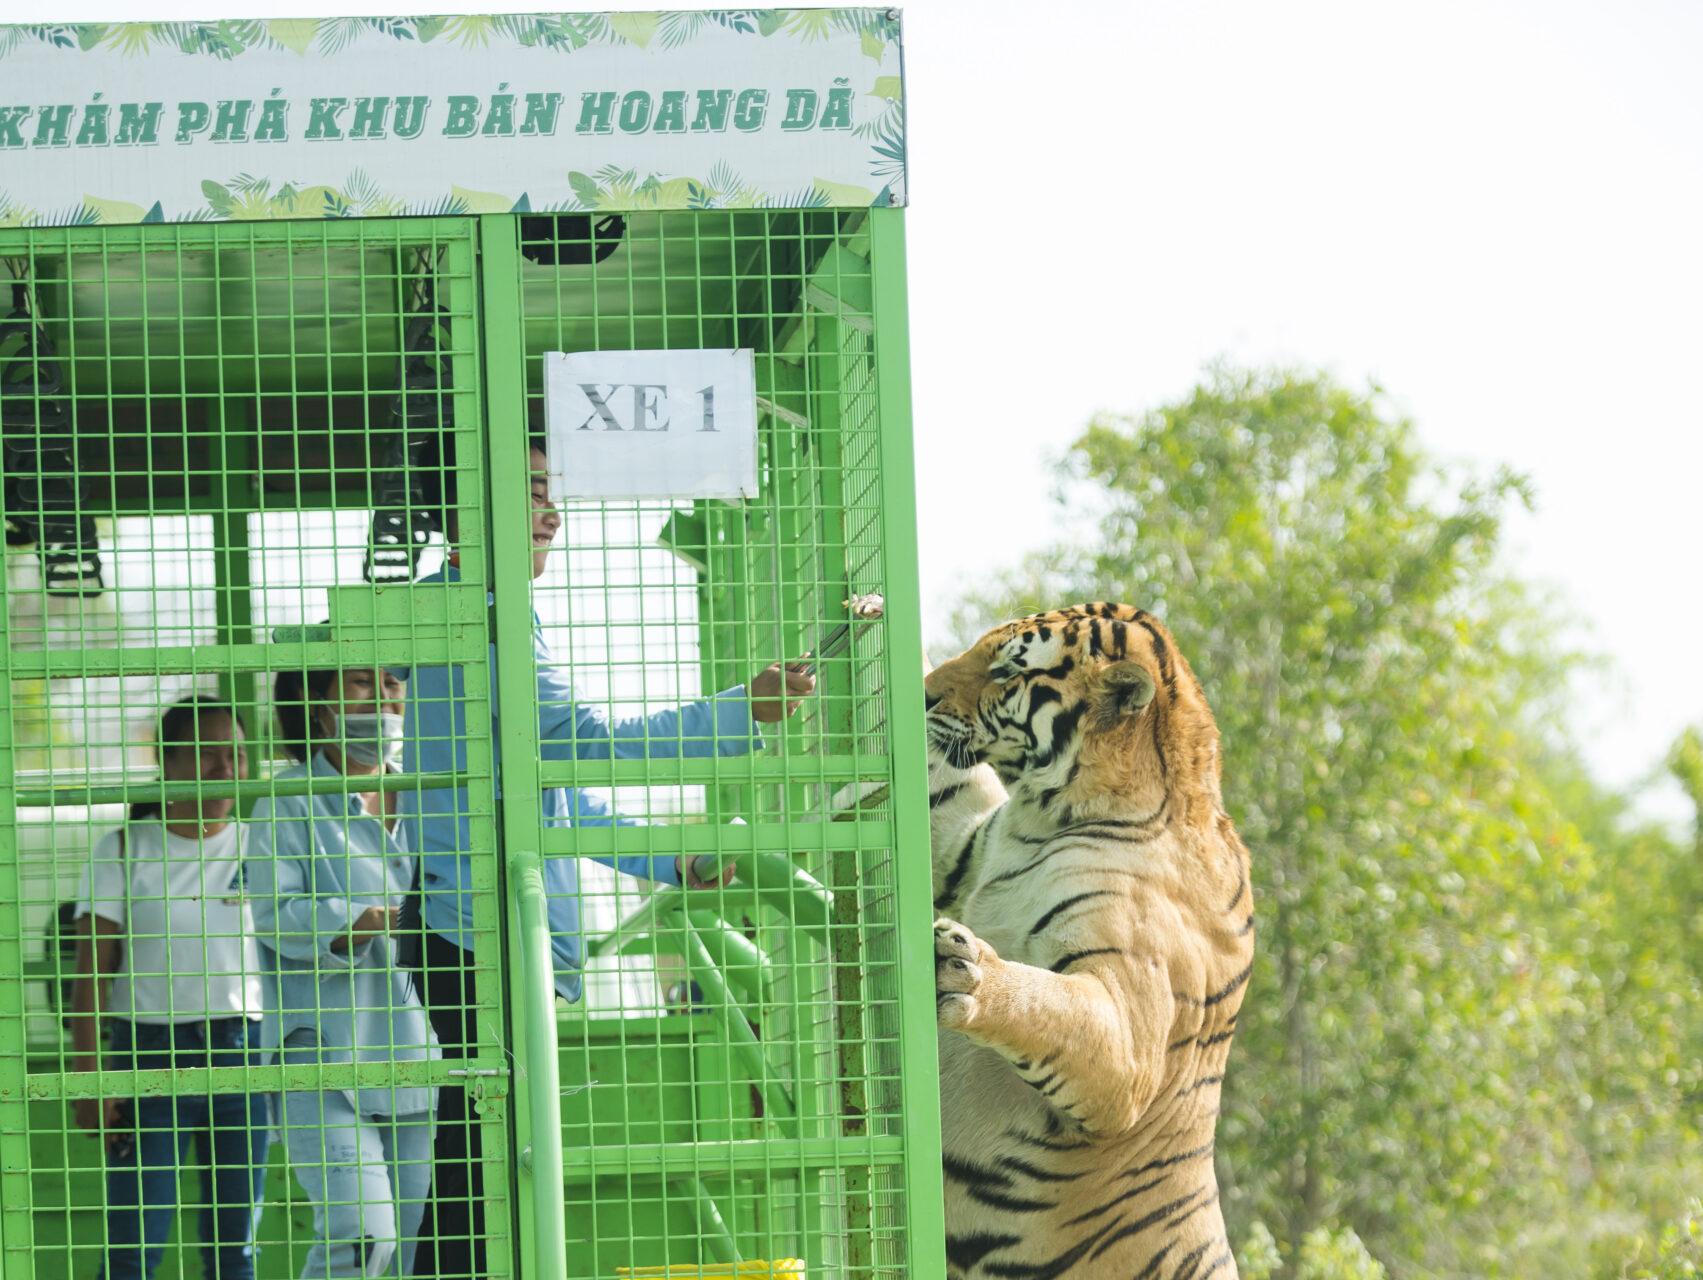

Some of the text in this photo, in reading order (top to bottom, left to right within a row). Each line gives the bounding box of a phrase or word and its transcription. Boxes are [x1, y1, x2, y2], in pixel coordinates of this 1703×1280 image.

[0, 77, 855, 148] KHÁM PHÁ KHU BÁN HOANG DÃ
[576, 383, 721, 432] XE 1
